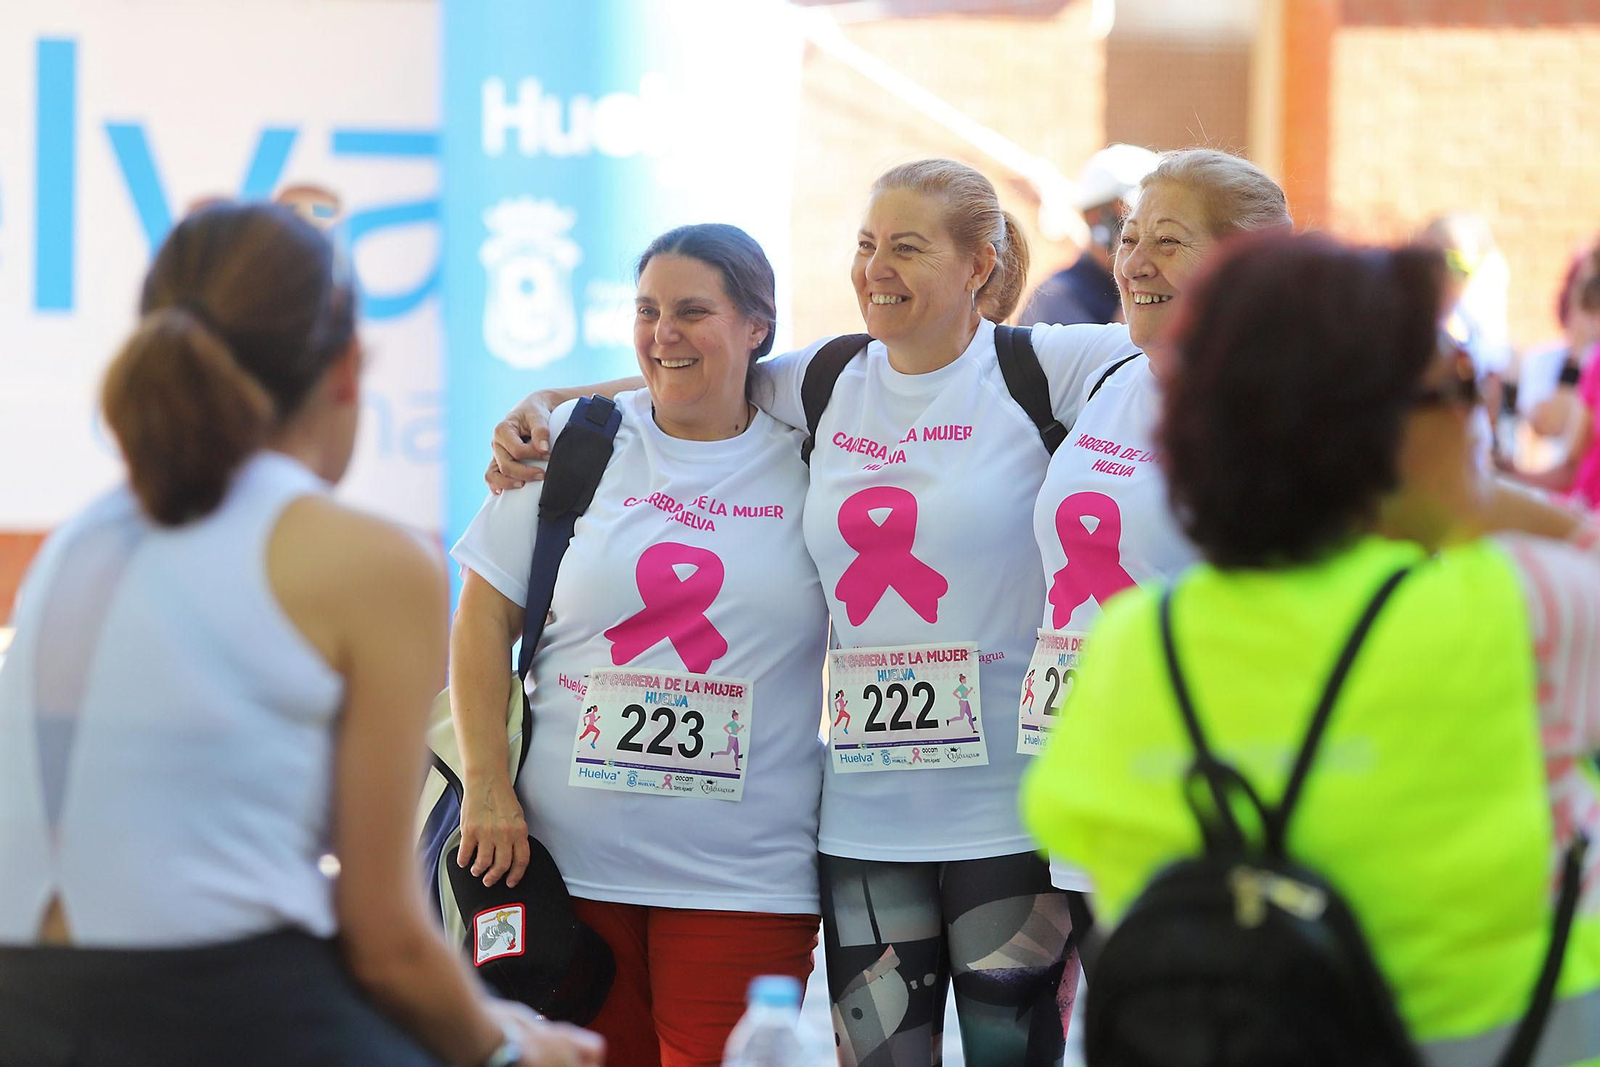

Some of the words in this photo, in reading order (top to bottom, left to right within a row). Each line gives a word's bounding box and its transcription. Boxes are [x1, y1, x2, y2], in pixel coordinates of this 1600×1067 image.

[0, 37, 438, 319] lva
[923, 425, 972, 442] MUJER
[862, 449, 907, 471] HUVA
[1119, 448, 1142, 460] DE
[1091, 458, 1136, 477] HUELVA
[623, 491, 684, 514] CRERA
[708, 498, 728, 517] LA
[733, 505, 784, 520] MUJER
[666, 511, 716, 532] UELVA
[1071, 638, 1084, 651] DE
[847, 653, 888, 668] CARRERA
[889, 652, 905, 666] DE
[908, 651, 923, 665] LA
[926, 649, 968, 663] MUJER
[558, 673, 588, 696] Huelva
[877, 667, 916, 682] HUELVA
[609, 673, 661, 689] CARRERA
[664, 677, 681, 691] DE
[684, 680, 700, 694] LA
[704, 681, 744, 698] MUJER
[1043, 666, 1080, 717] 22
[645, 690, 689, 708] HUELVA
[863, 681, 939, 732] 222
[616, 704, 705, 758] 223
[840, 753, 873, 763] Huelva
[579, 767, 617, 780] Huelva
